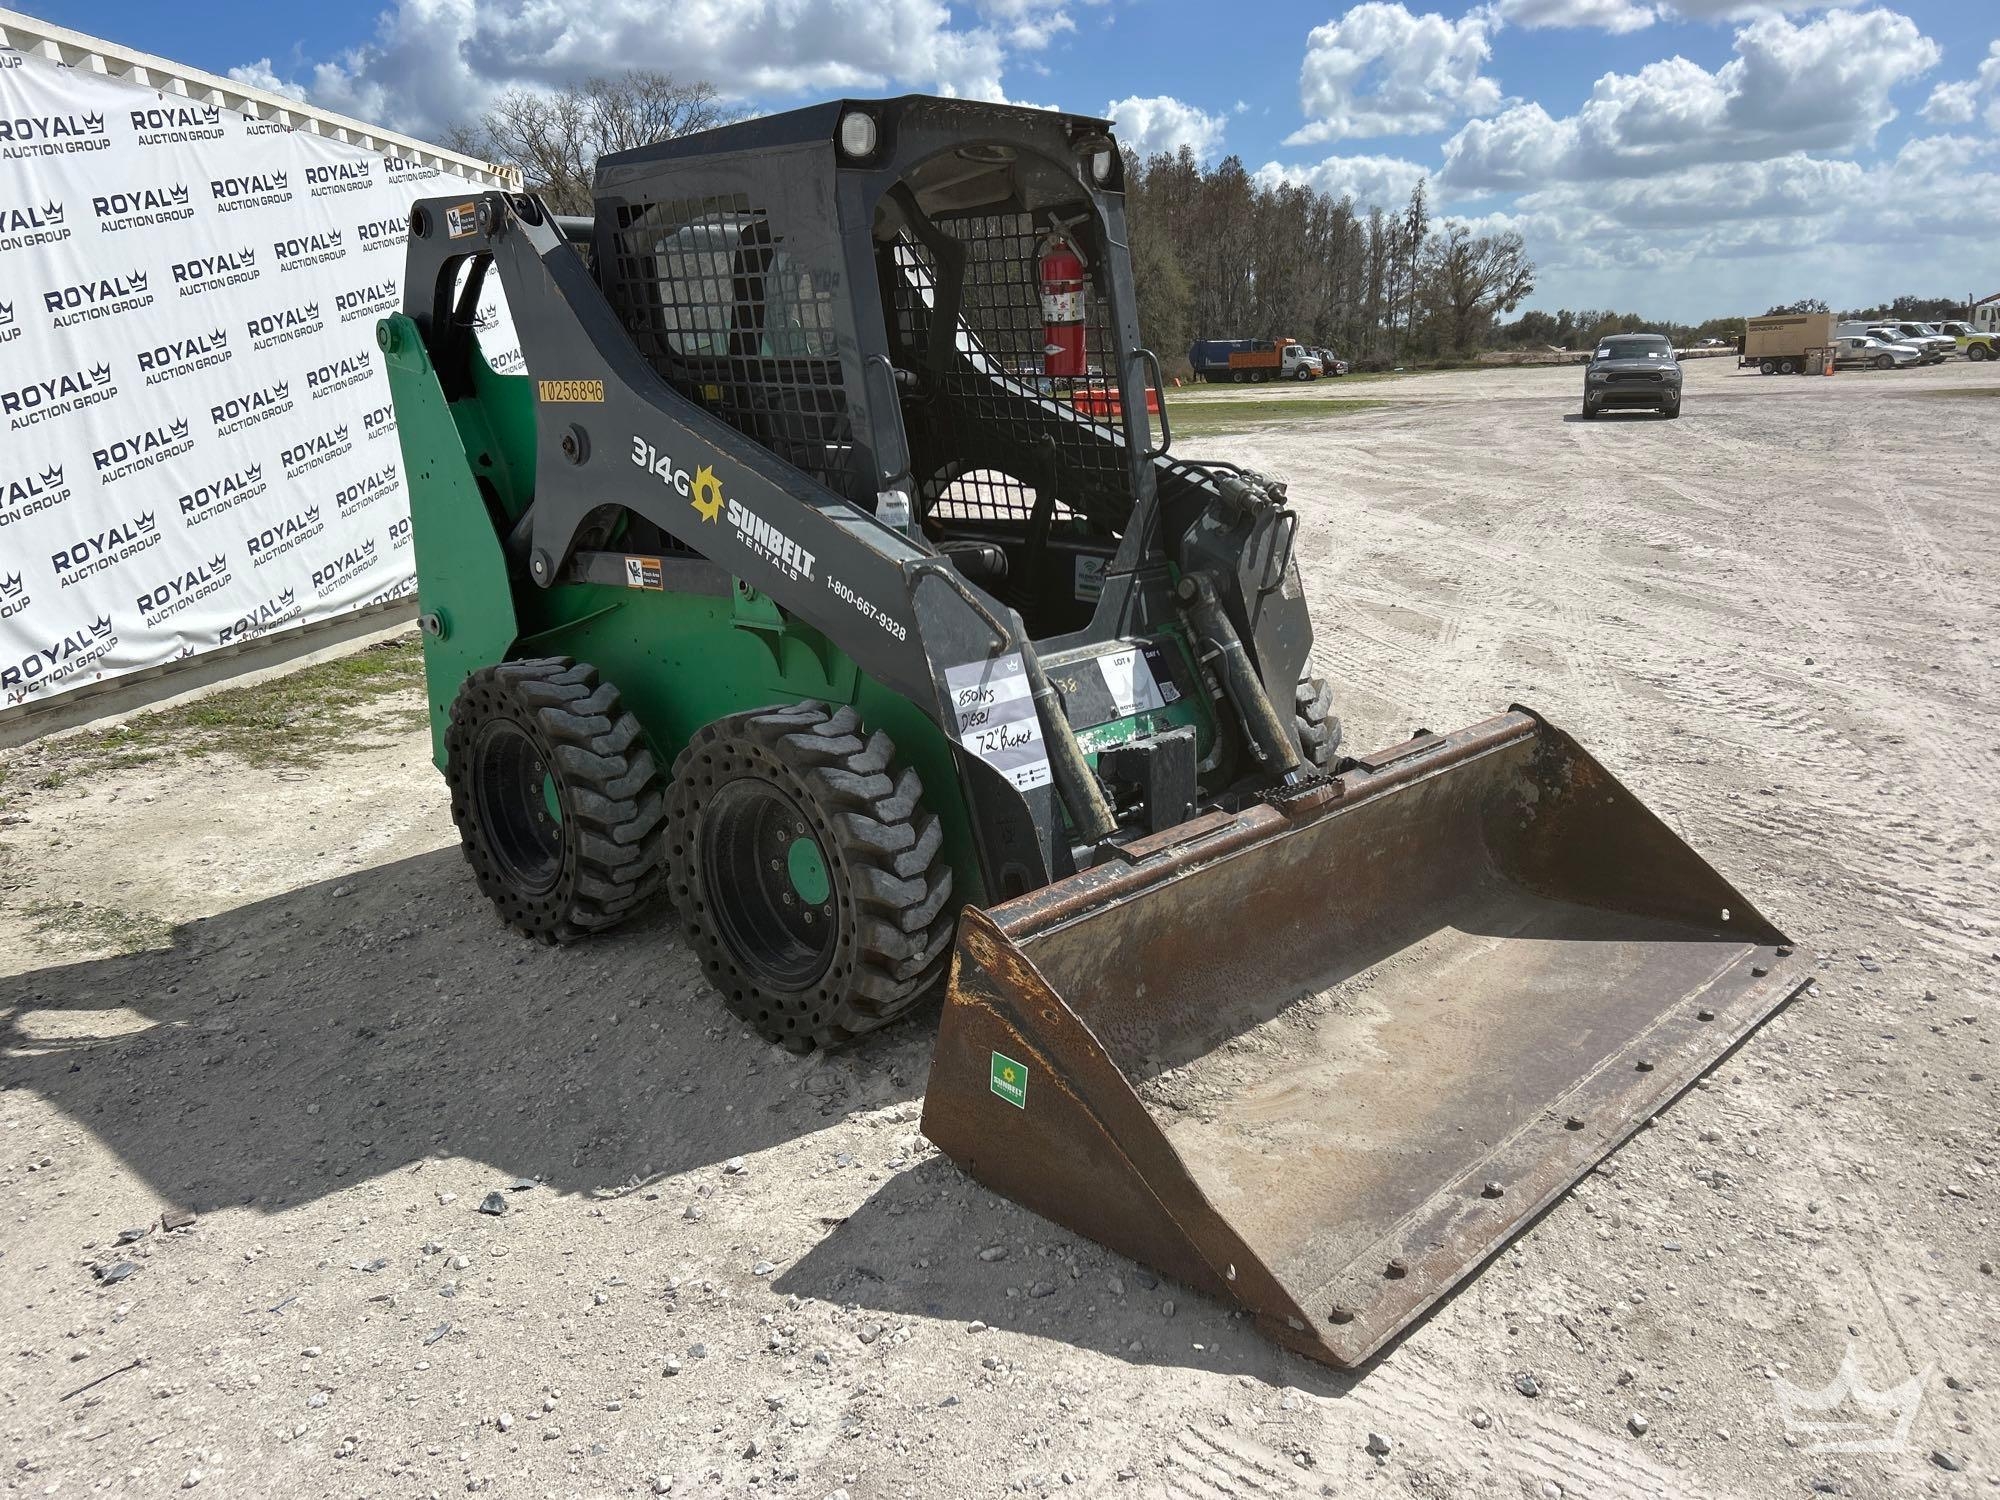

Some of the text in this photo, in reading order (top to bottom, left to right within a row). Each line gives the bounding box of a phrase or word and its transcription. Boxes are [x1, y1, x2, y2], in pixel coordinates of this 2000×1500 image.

[0, 116, 85, 142] ROYAL
[130, 108, 203, 130] ROYAL
[247, 124, 287, 136] AUCTION
[3, 139, 110, 159] AUCTION GROUP
[139, 129, 224, 146] AUCTION GROUP
[210, 175, 274, 198] ROYAL
[305, 163, 358, 184] ROYAL
[312, 180, 372, 197] AUCTION GROUP
[389, 170, 440, 184] AUCTION GROUP
[92, 189, 172, 217] ROYAL
[218, 192, 292, 213] AUCTION GROUP
[102, 208, 194, 232] AUCTION GROUP
[358, 218, 405, 240] ROYAL
[24, 229, 71, 246] GROUP
[274, 234, 330, 259] ROYAL
[363, 235, 409, 252] AUCTION GRO
[172, 253, 241, 283] ROYAL
[281, 249, 346, 272] AUCTION GROUP
[43, 278, 130, 312] ROYAL
[180, 270, 260, 297] AUCTION GROUP
[335, 285, 385, 311] ROYAL
[54, 295, 153, 329] AUCTION GROUP
[247, 308, 306, 338] ROYAL
[341, 298, 400, 323] AUCTION GROUP
[254, 322, 323, 351] AUCTION GROUP
[137, 336, 211, 372] ROYAL
[146, 351, 232, 386] AUCTION GROUP
[306, 358, 359, 388] ROYAL
[313, 369, 373, 400] AUCTION GROUP
[1, 372, 92, 414] ROYAL
[211, 389, 275, 424] ROYAL
[540, 381, 603, 400] 10256896
[11, 387, 118, 431] AUCTION GROUP
[218, 401, 293, 438] AUCTION GROUP
[363, 404, 393, 430] ROY
[92, 428, 172, 470] ROYAL
[102, 440, 194, 485] AUCTION GROUP
[281, 432, 336, 468] ROYAL
[287, 443, 352, 480] AUCTION GROUP
[631, 436, 690, 497] 314G
[23, 489, 70, 516] GROUP
[179, 473, 248, 515] ROYAL
[187, 483, 266, 528] AUCTION GROUP
[336, 473, 384, 508] ROYAL
[342, 481, 399, 519] AUCTION GROUP
[52, 524, 138, 574] ROYAL
[247, 515, 307, 556] ROYAL
[254, 523, 324, 568] AUCTION GROUP
[727, 498, 815, 581] SUNBELT
[62, 533, 161, 588] AUCTION GROUP
[312, 548, 364, 588] ROYAL
[736, 530, 798, 582] RENTALS
[137, 566, 211, 615] ROYAL
[318, 555, 378, 598] AUCTION GROUP
[1, 596, 31, 619] OUP
[147, 574, 231, 628] AUCTION GROUP
[268, 605, 301, 629] GROUP
[827, 575, 907, 642] 1-800-667-9328
[219, 600, 282, 645] ROYAL
[1, 631, 94, 689] ROYAL
[7, 637, 118, 705] AUCTION GROUP
[1114, 657, 1126, 666] LOT
